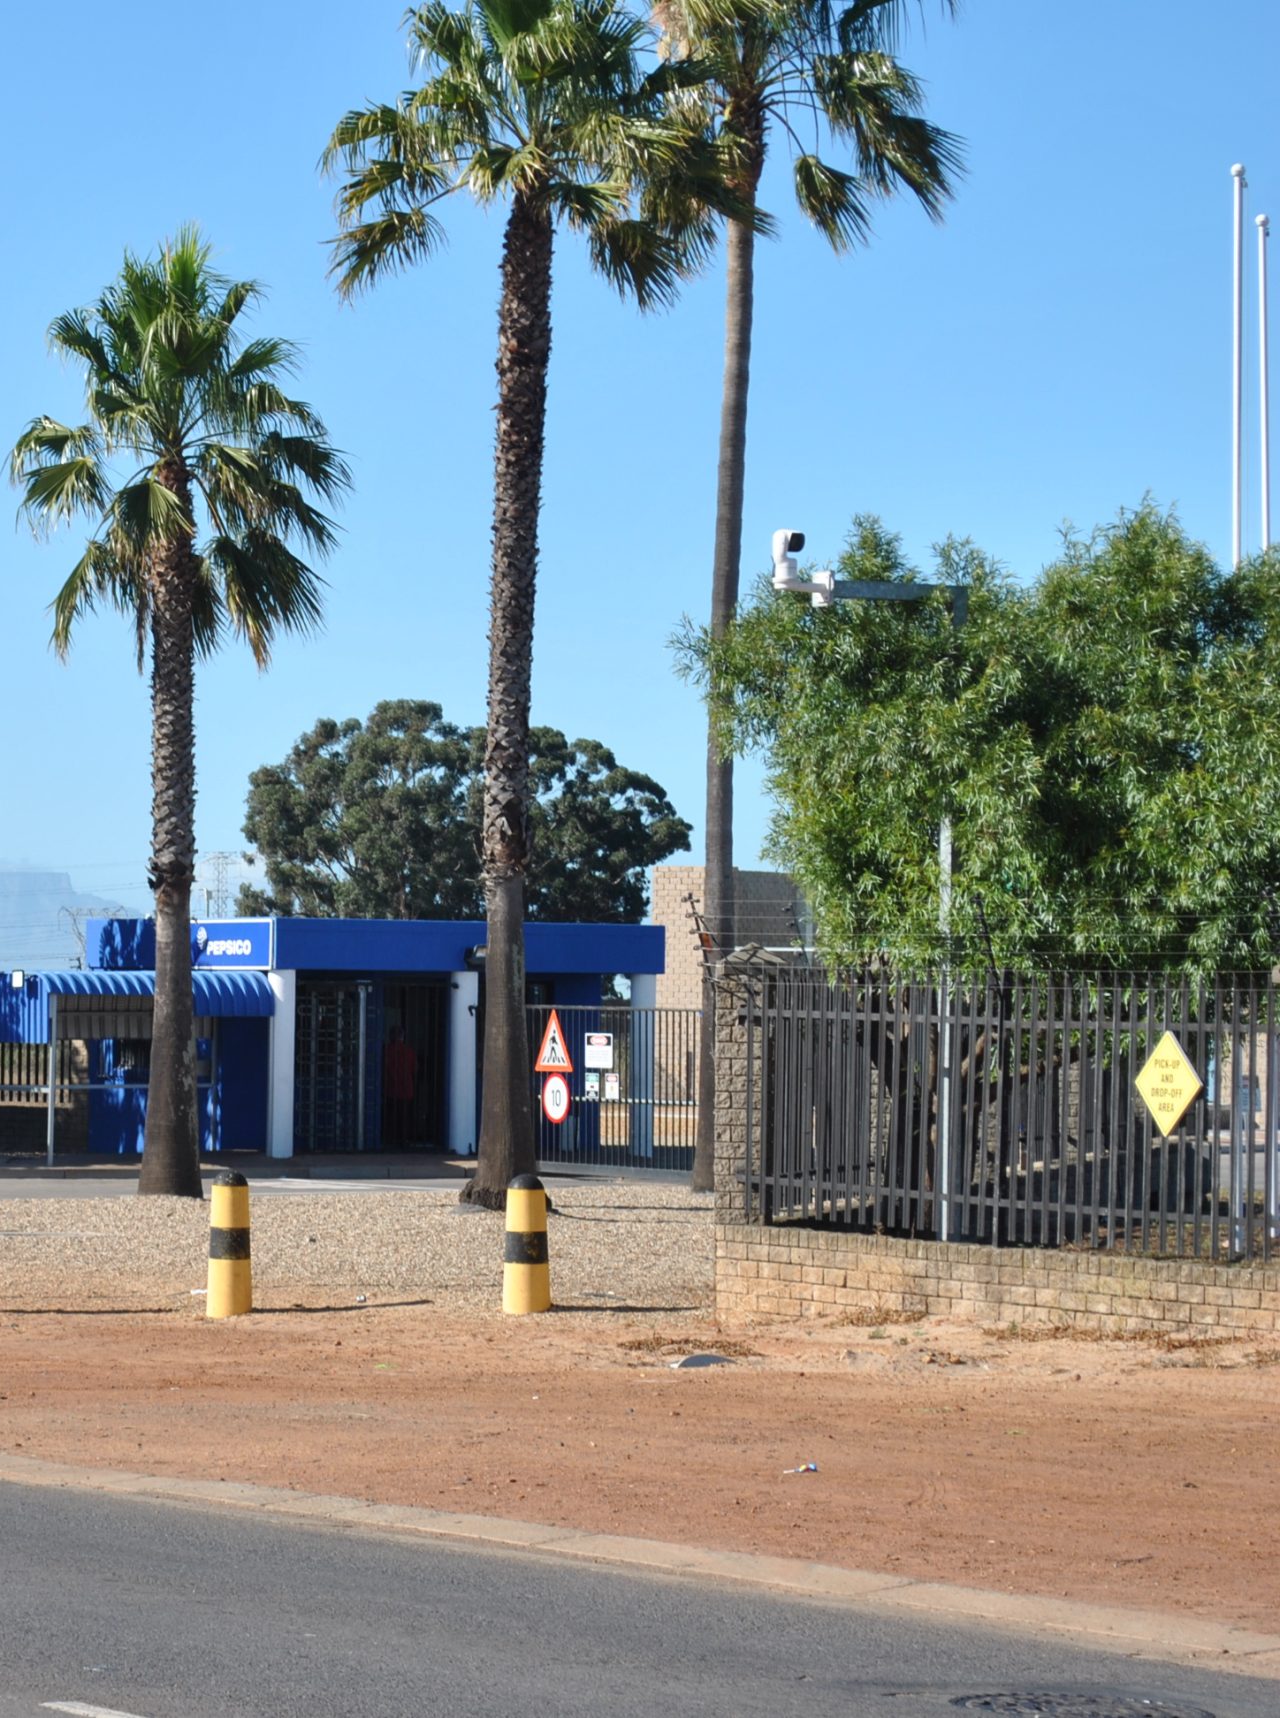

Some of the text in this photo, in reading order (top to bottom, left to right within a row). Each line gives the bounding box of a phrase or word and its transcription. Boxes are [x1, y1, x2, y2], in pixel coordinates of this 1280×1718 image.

[206, 939, 252, 956] PEPSICO
[1154, 1059, 1181, 1069] PICK-UP
[1161, 1074, 1174, 1084] AND
[551, 1089, 561, 1107] 10
[1151, 1087, 1183, 1099] DROP-OFF
[1158, 1102, 1175, 1113] AREA
